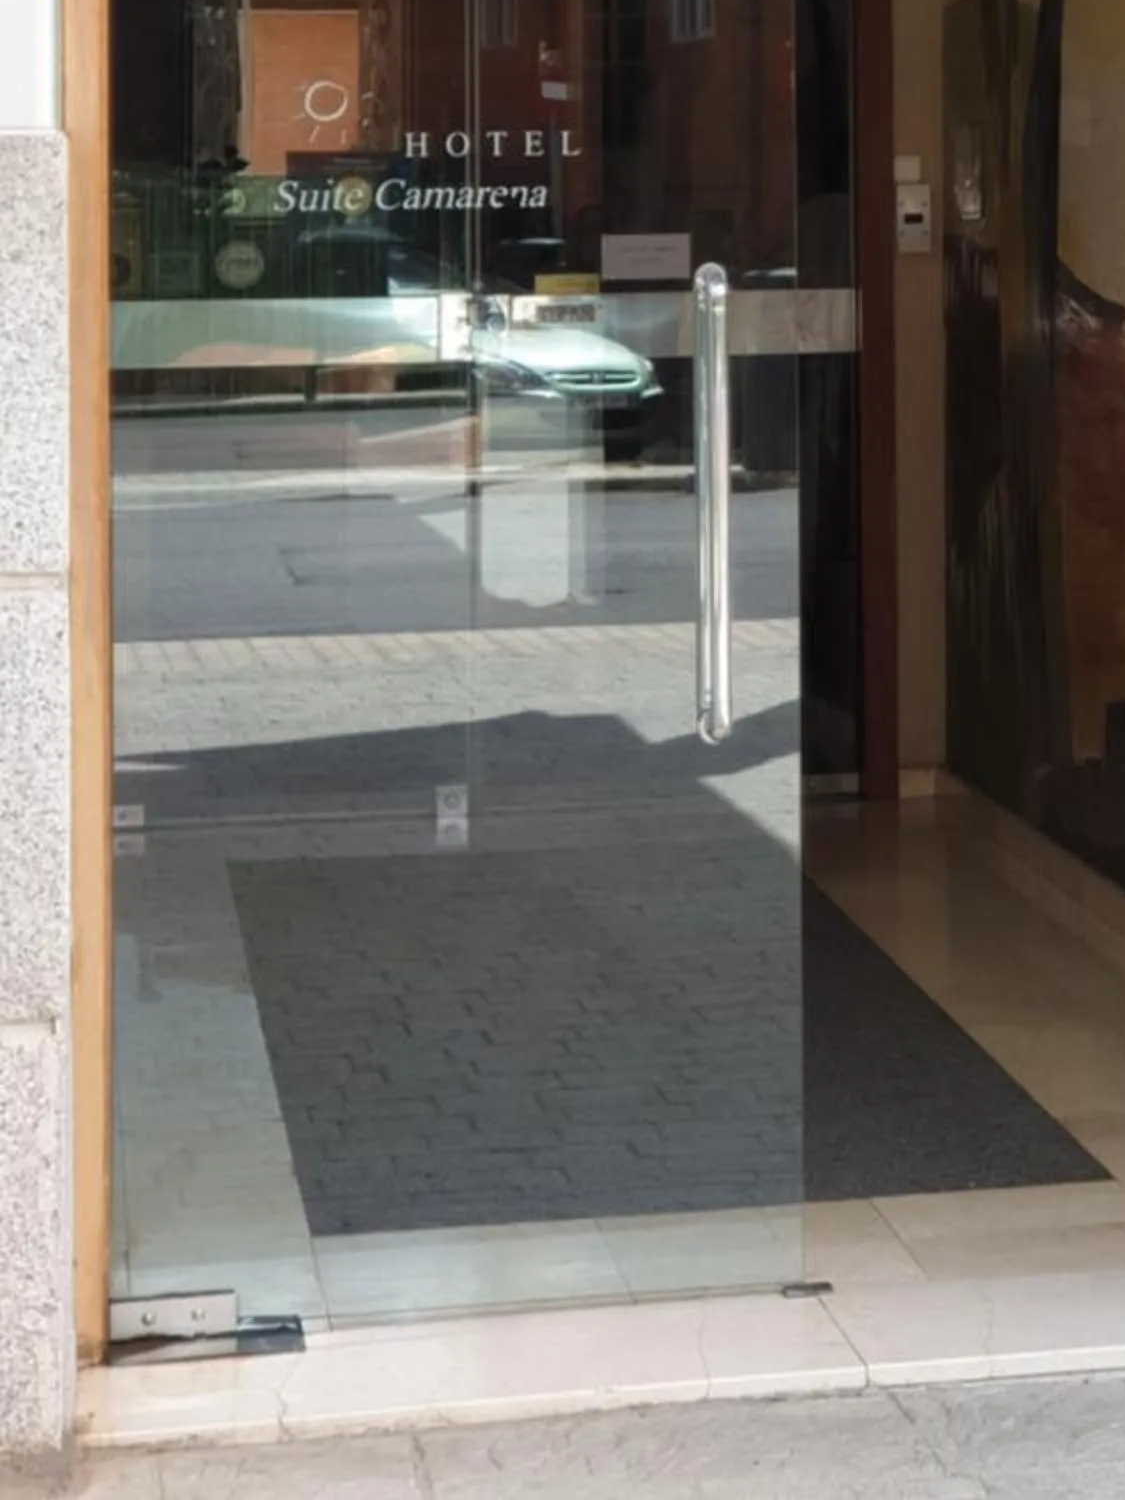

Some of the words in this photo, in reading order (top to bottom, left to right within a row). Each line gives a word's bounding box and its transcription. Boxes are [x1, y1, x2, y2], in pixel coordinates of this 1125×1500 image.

[404, 129, 584, 159] HOTEL
[273, 178, 365, 213] Suite
[375, 177, 549, 211] Camarena
